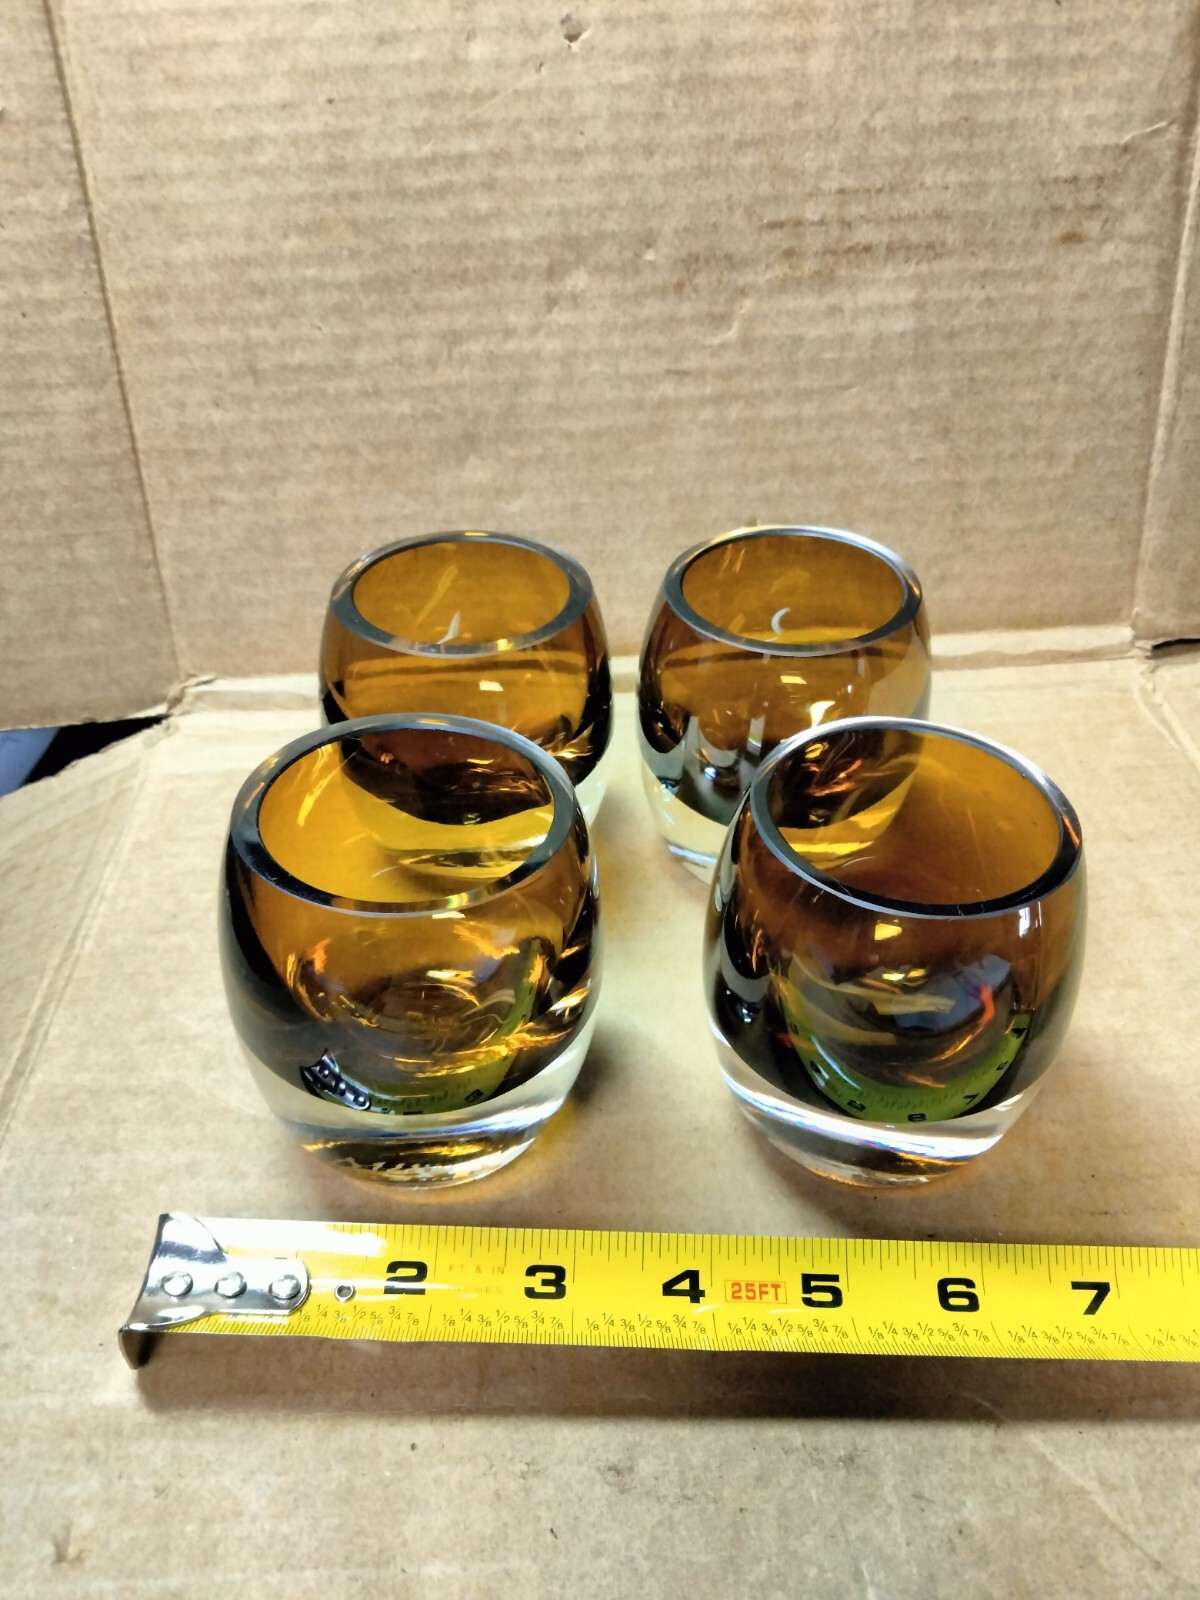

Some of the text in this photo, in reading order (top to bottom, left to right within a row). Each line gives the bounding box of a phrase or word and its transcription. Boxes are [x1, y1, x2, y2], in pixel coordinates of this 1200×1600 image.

[384, 1260, 428, 1295] 2
[524, 1264, 566, 1300] 3
[662, 1269, 705, 1304] 4
[731, 1282, 781, 1301] 25FT
[801, 1273, 843, 1308] 5
[937, 1277, 980, 1312] 6
[1071, 1281, 1110, 1315] 7
